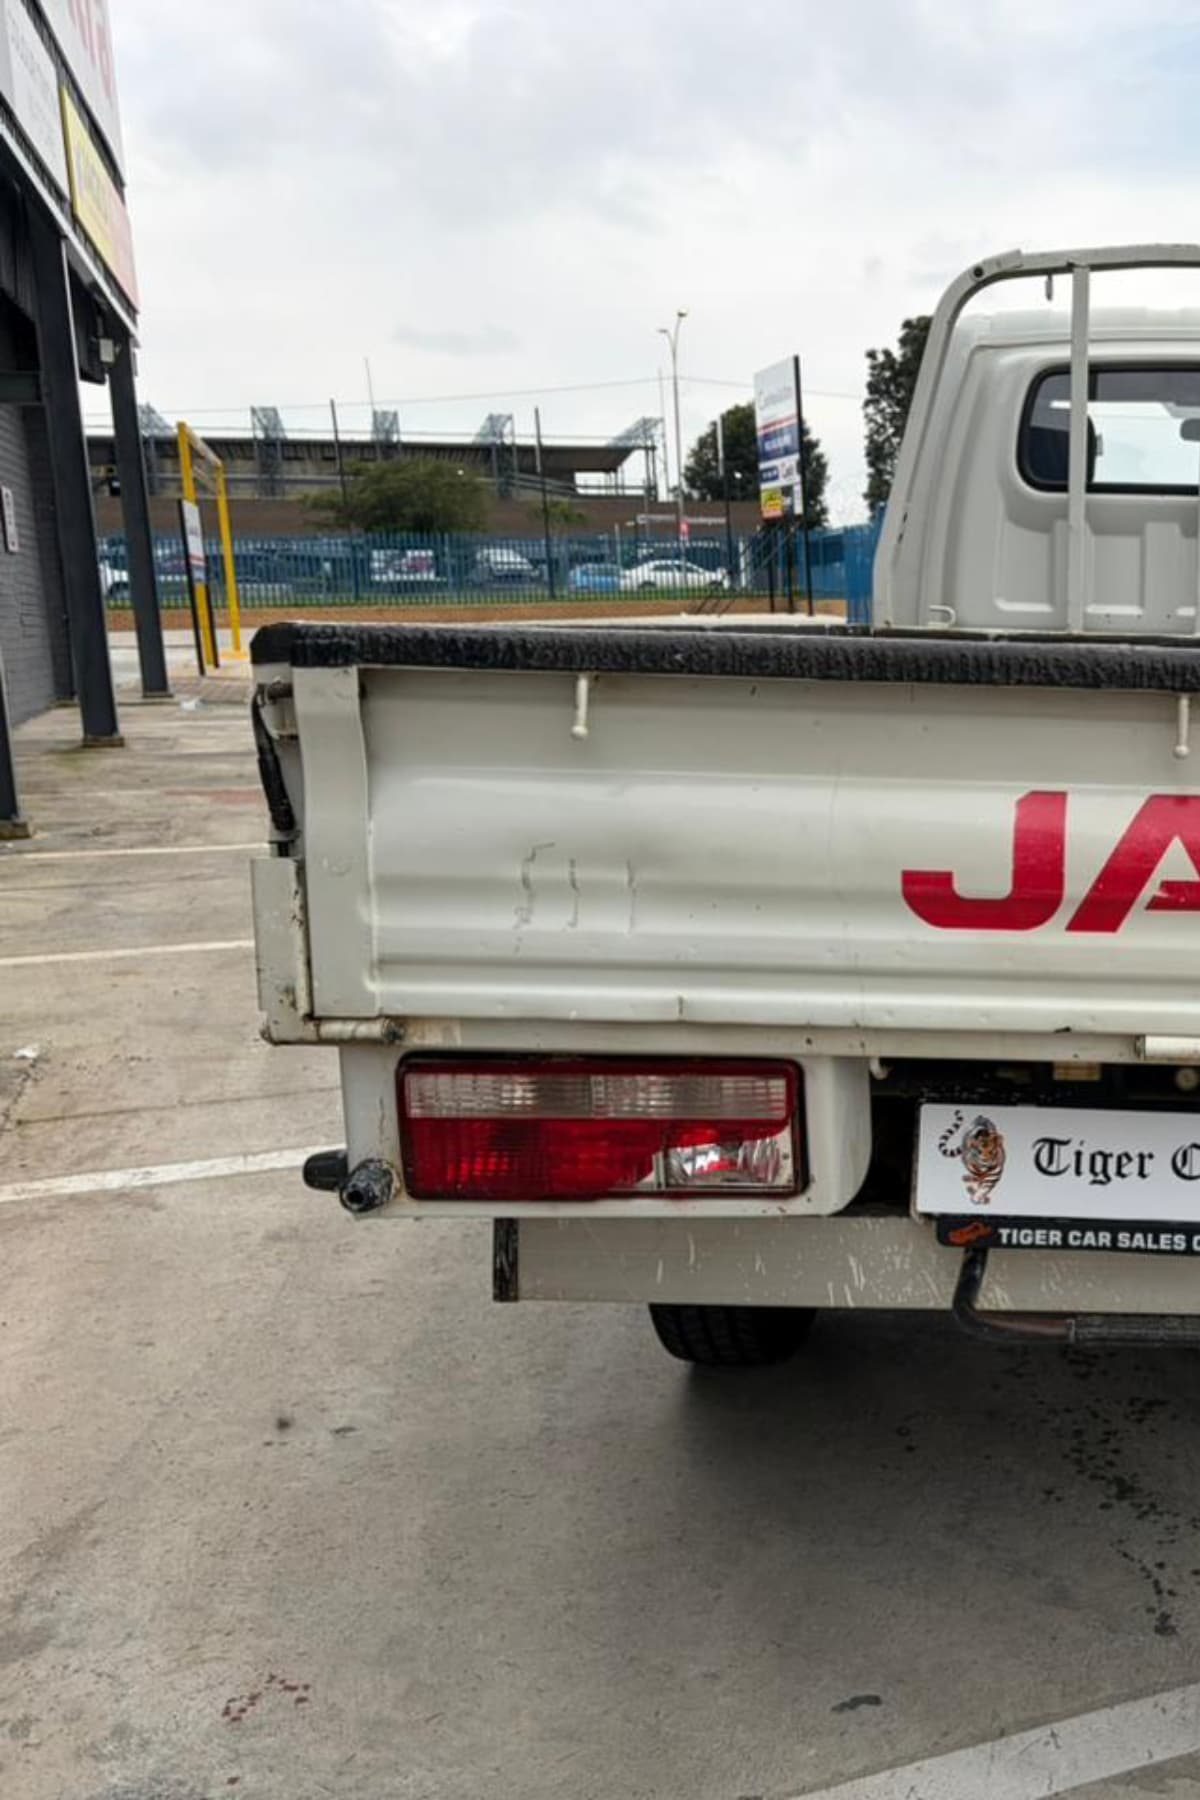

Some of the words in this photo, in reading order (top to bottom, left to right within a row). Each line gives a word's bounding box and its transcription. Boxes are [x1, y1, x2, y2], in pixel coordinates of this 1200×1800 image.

[1032, 1136, 1154, 1186] Tiger
[998, 1228, 1062, 1246] TIGER
[1067, 1230, 1112, 1248] CAR
[1117, 1232, 1187, 1251] SALES
